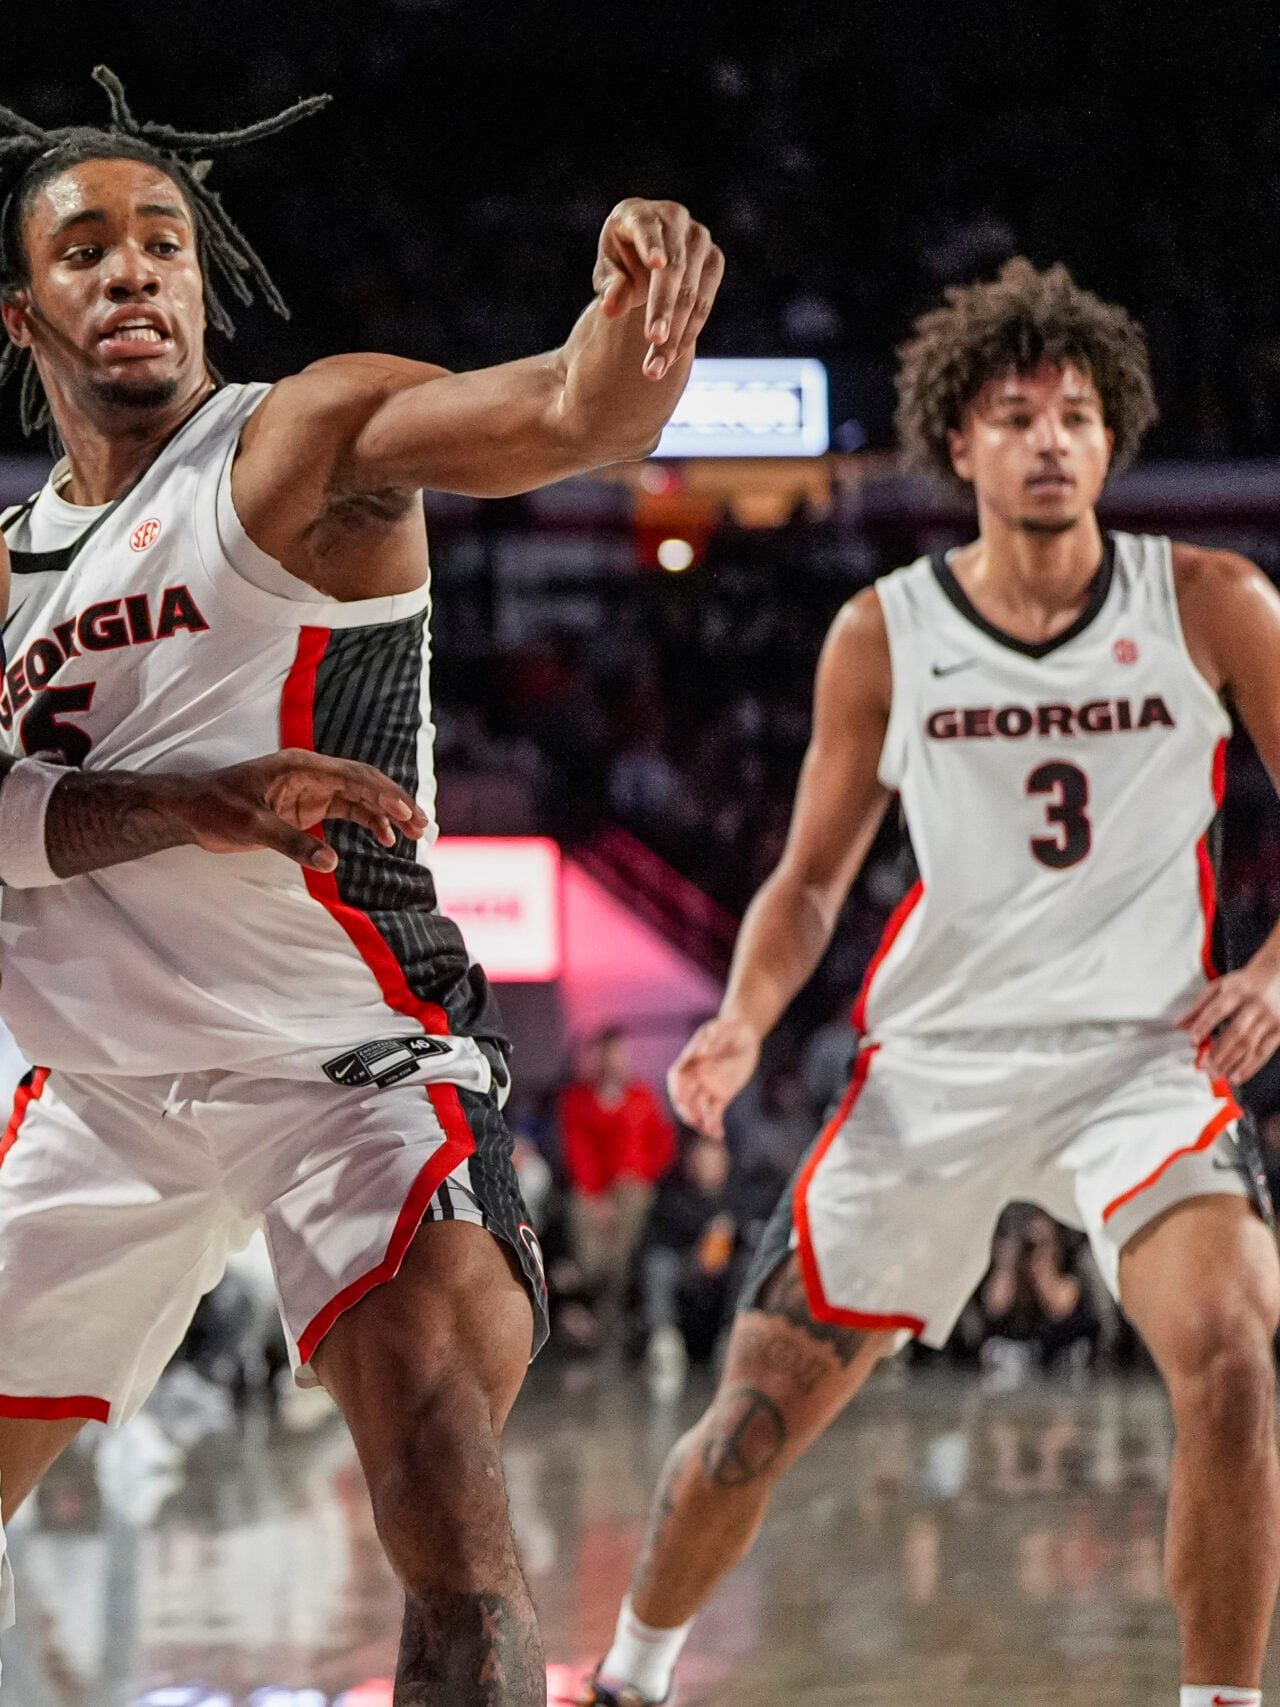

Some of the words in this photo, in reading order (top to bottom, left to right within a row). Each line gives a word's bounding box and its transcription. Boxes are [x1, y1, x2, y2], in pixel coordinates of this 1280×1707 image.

[20, 681, 97, 770] 5
[926, 695, 1175, 738] GEORGIA
[1026, 759, 1091, 869] 3
